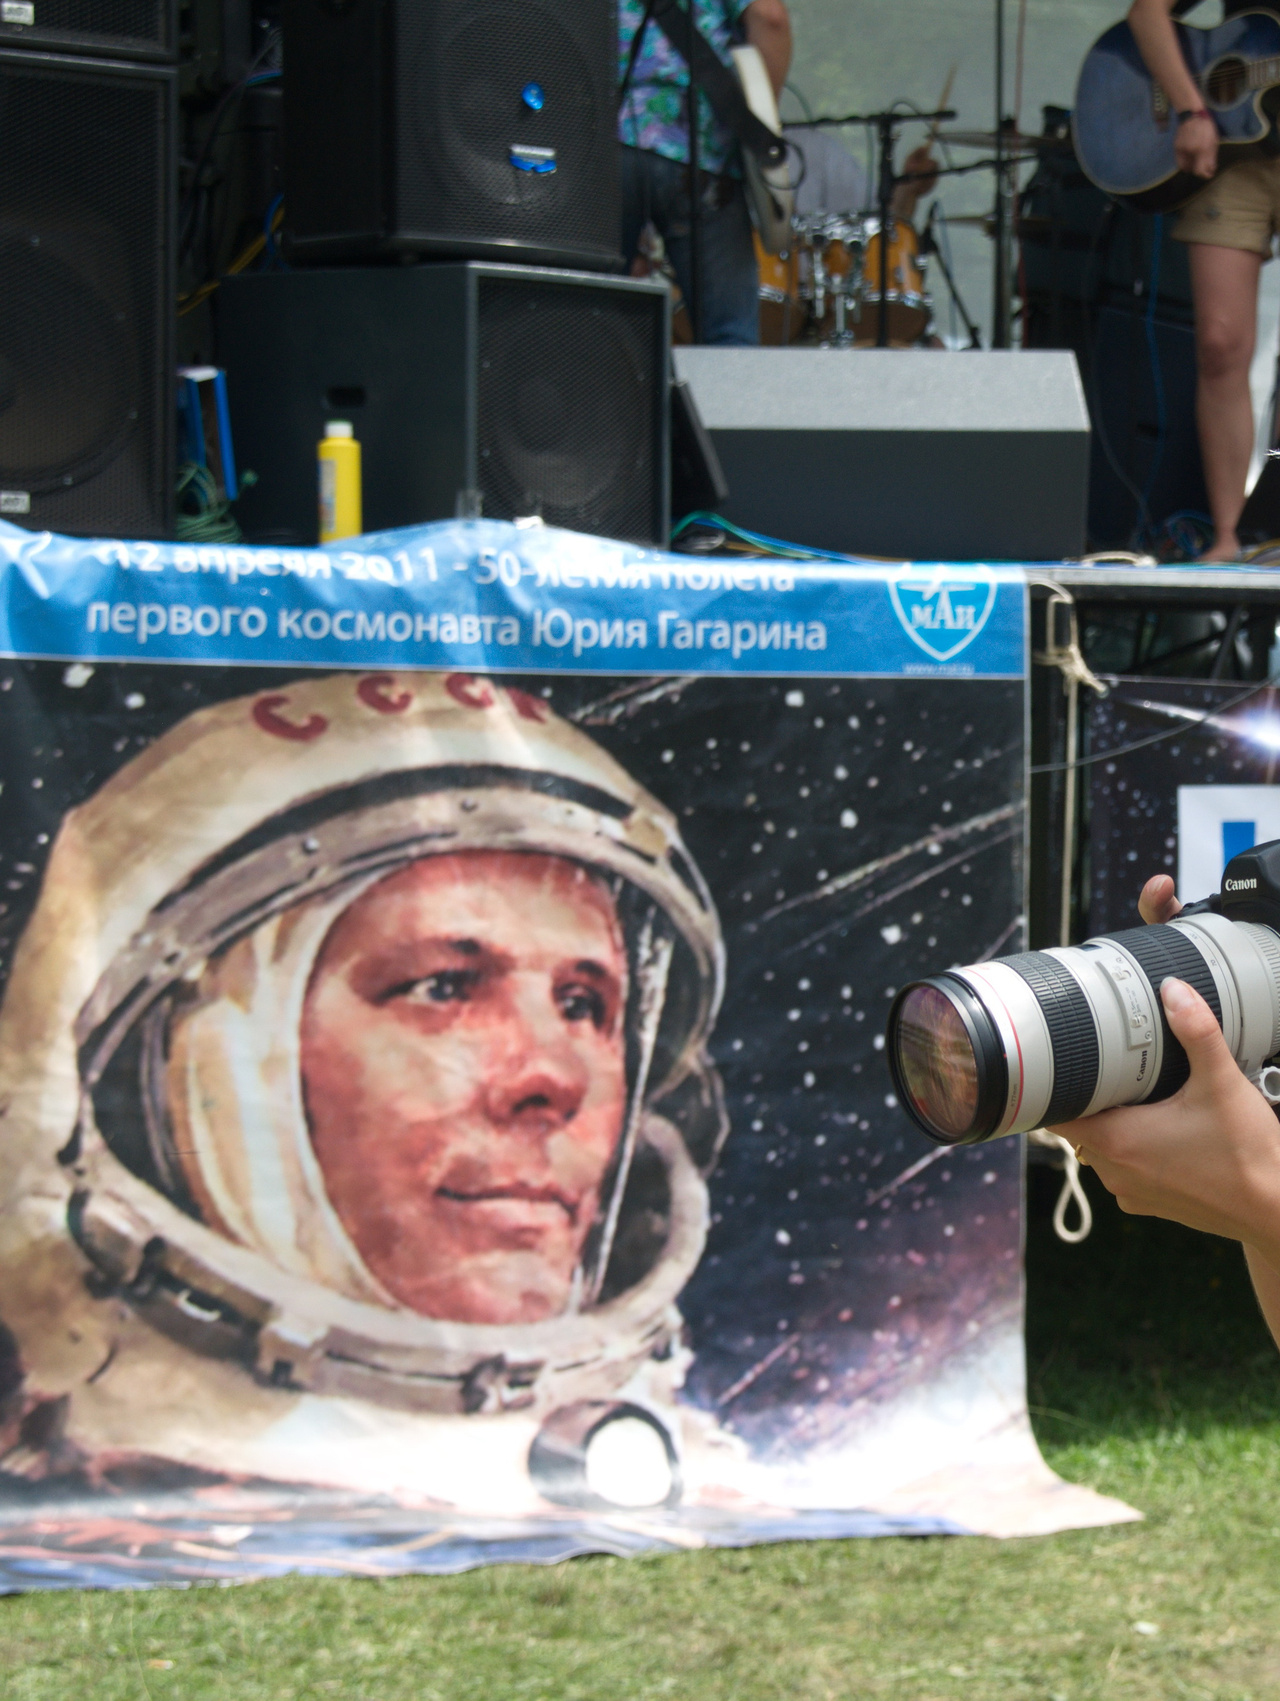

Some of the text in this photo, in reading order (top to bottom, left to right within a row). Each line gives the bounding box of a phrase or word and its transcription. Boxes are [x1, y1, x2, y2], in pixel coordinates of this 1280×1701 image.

[338, 546, 439, 587] 2011
[86, 601, 828, 660] первого космонавта Юрия Гагарина
[1224, 877, 1258, 892] Canon
[1136, 1050, 1148, 1082] Canon
